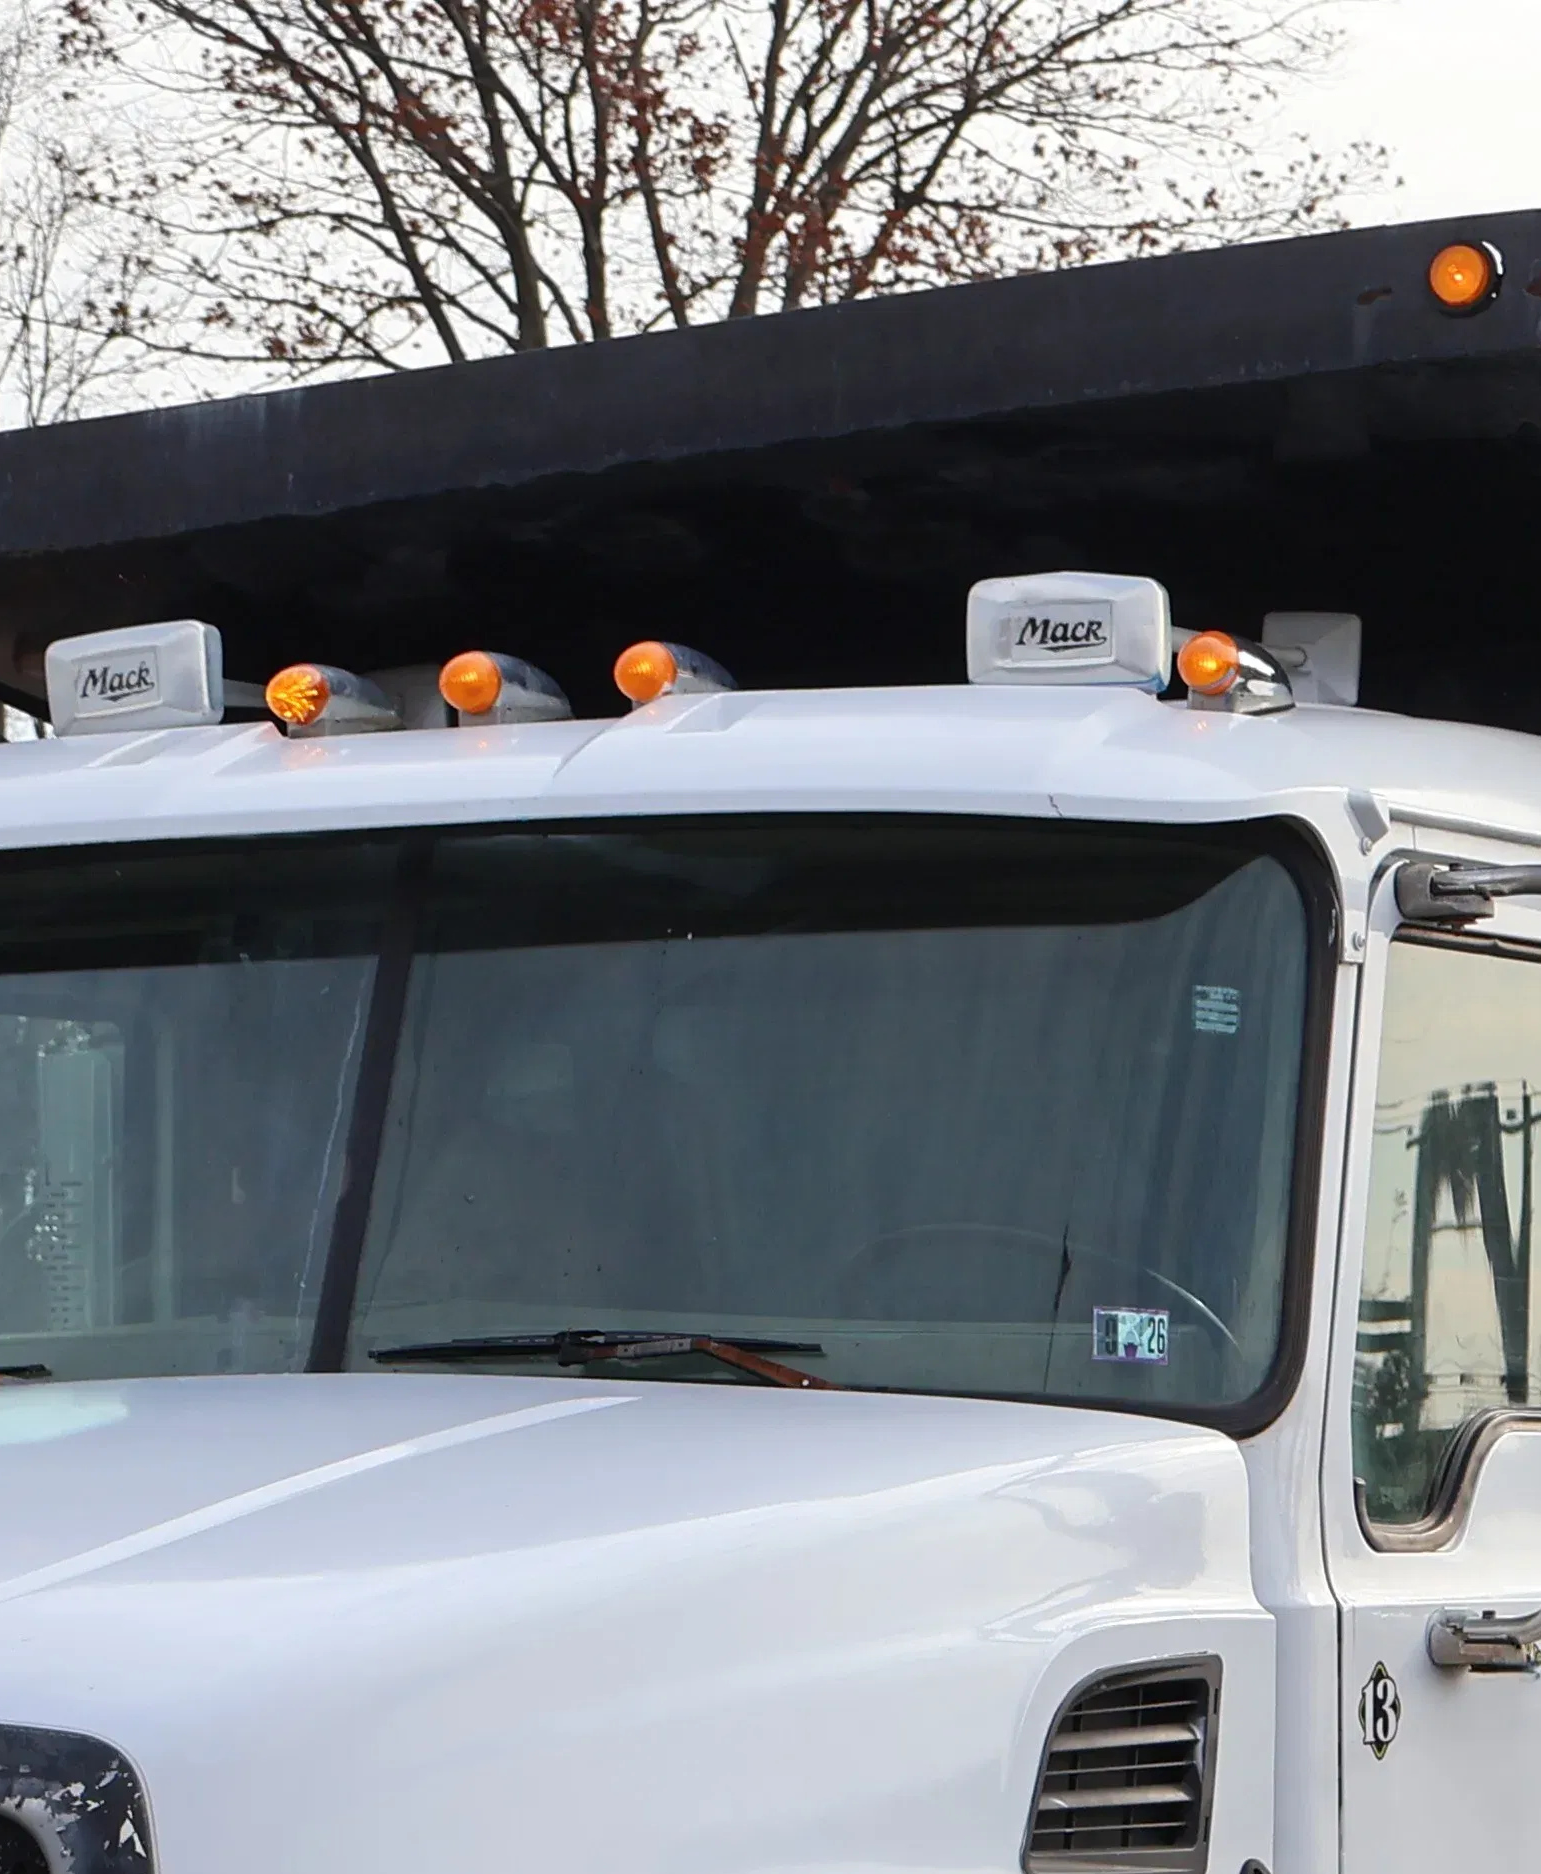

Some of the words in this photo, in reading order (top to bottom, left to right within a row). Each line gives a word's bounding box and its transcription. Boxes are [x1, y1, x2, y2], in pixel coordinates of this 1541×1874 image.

[1015, 616, 1107, 653] Mack
[79, 660, 155, 702] Mack
[1147, 1316, 1166, 1354] 26
